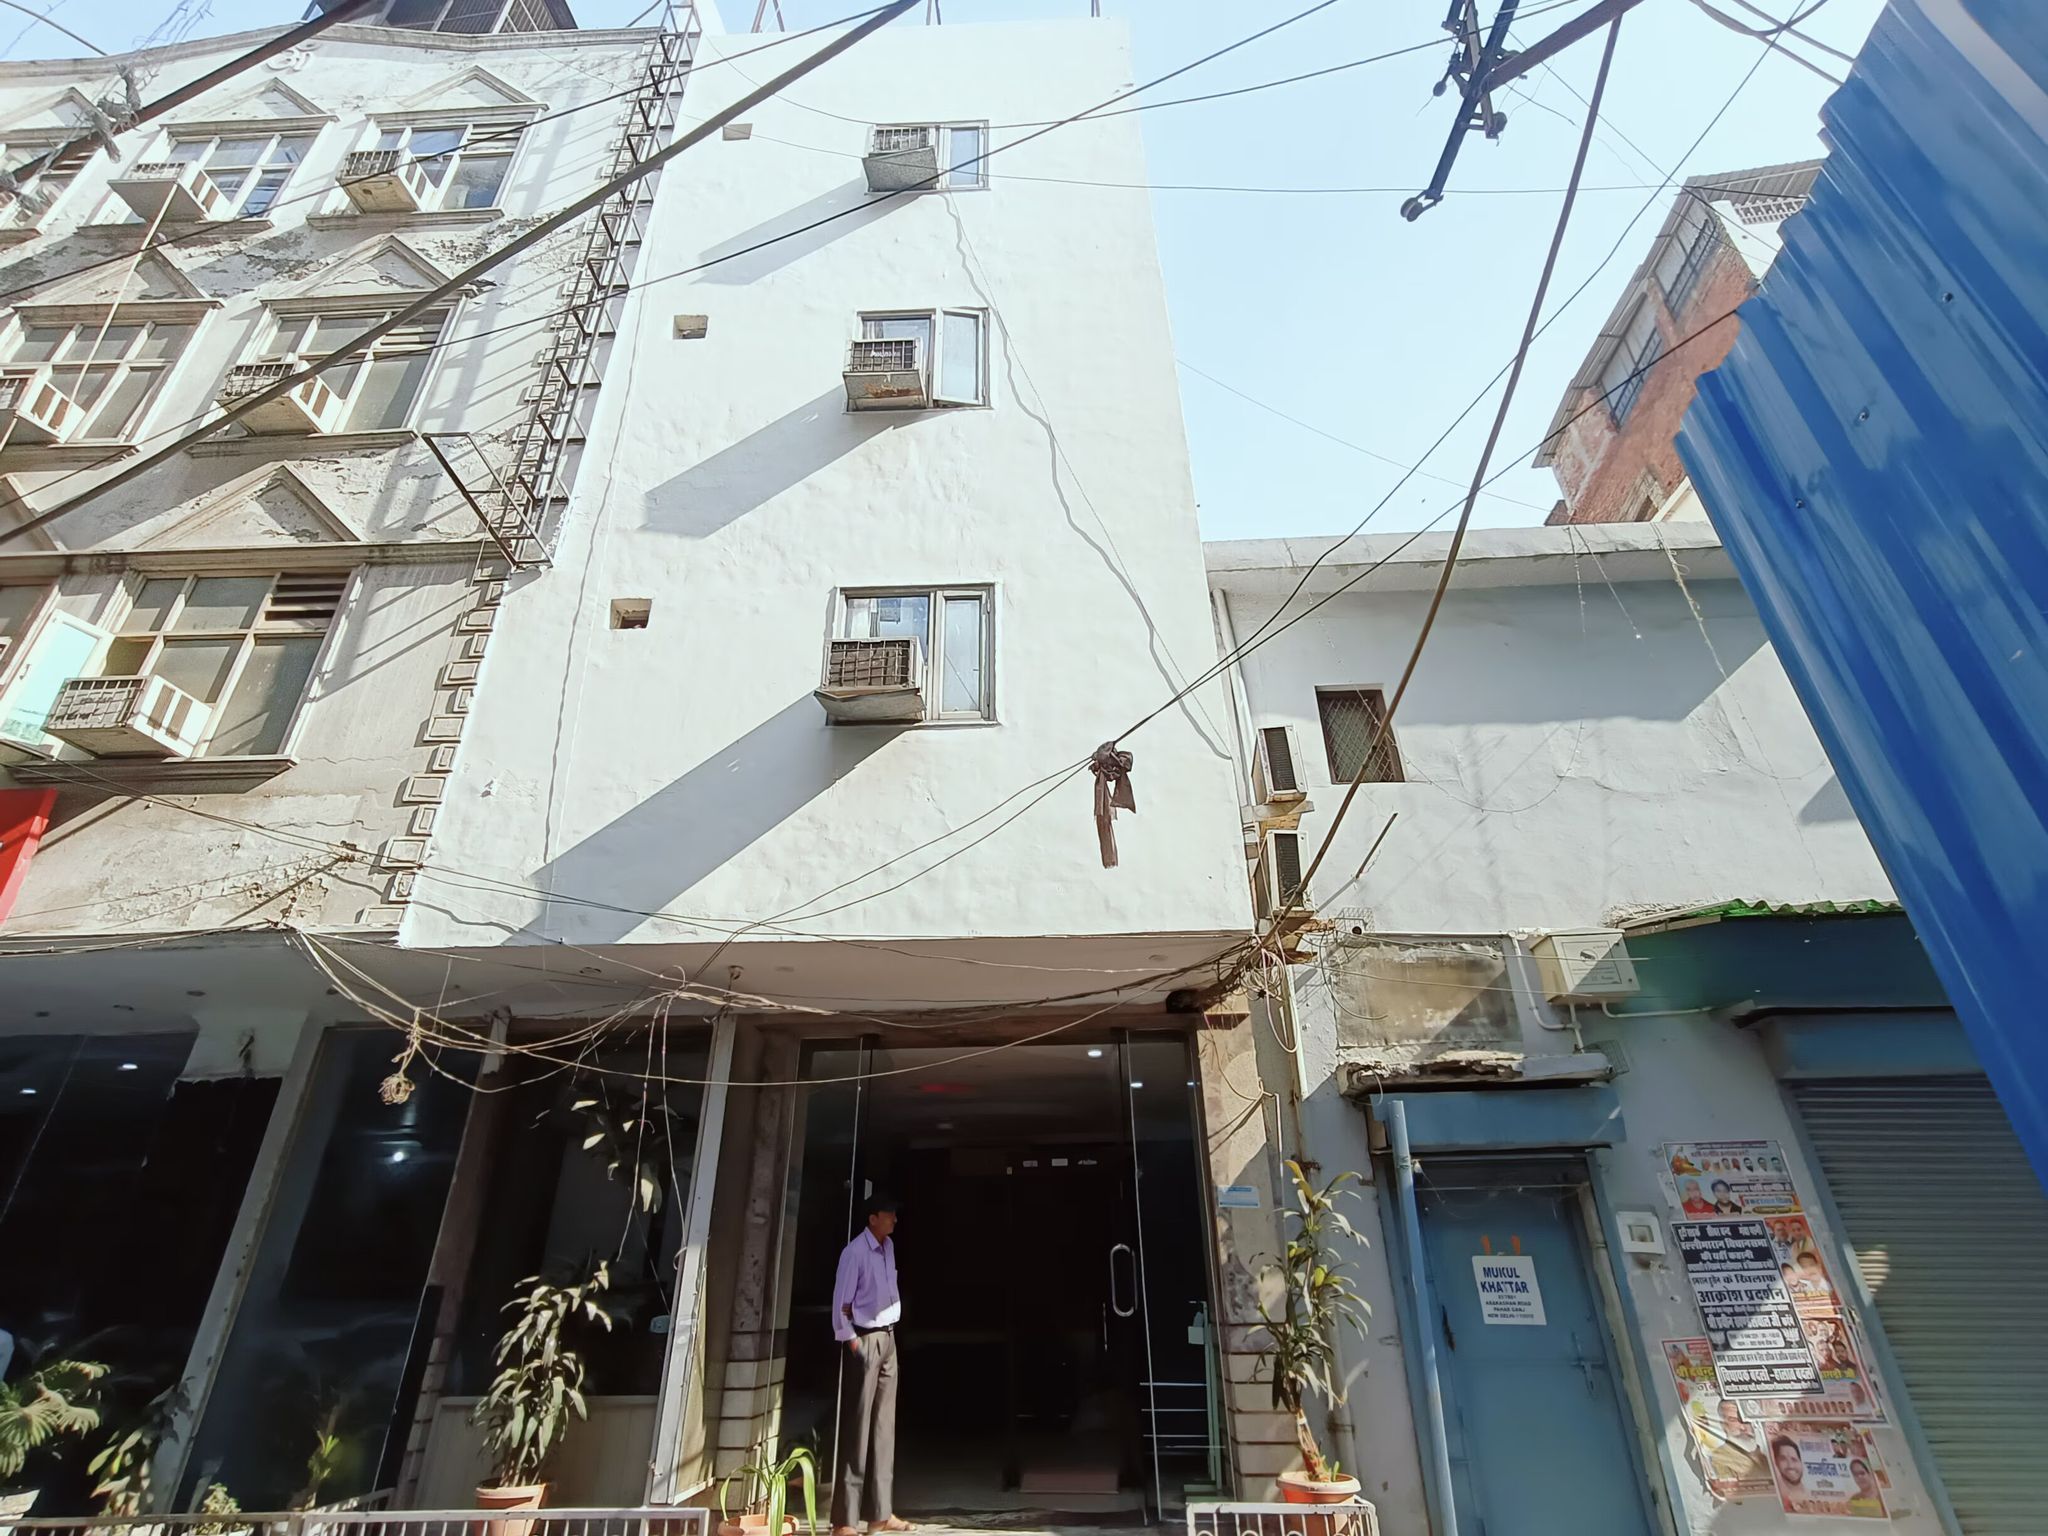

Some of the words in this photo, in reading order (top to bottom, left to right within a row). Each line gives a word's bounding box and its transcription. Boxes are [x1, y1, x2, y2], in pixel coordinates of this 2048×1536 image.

[1482, 1267, 1520, 1278] MUKUL
[1480, 1281, 1529, 1293] KHATTAR
[1697, 1285, 1744, 1303] आक्रोश
[1744, 1284, 1785, 1301] प्रदर्शन
